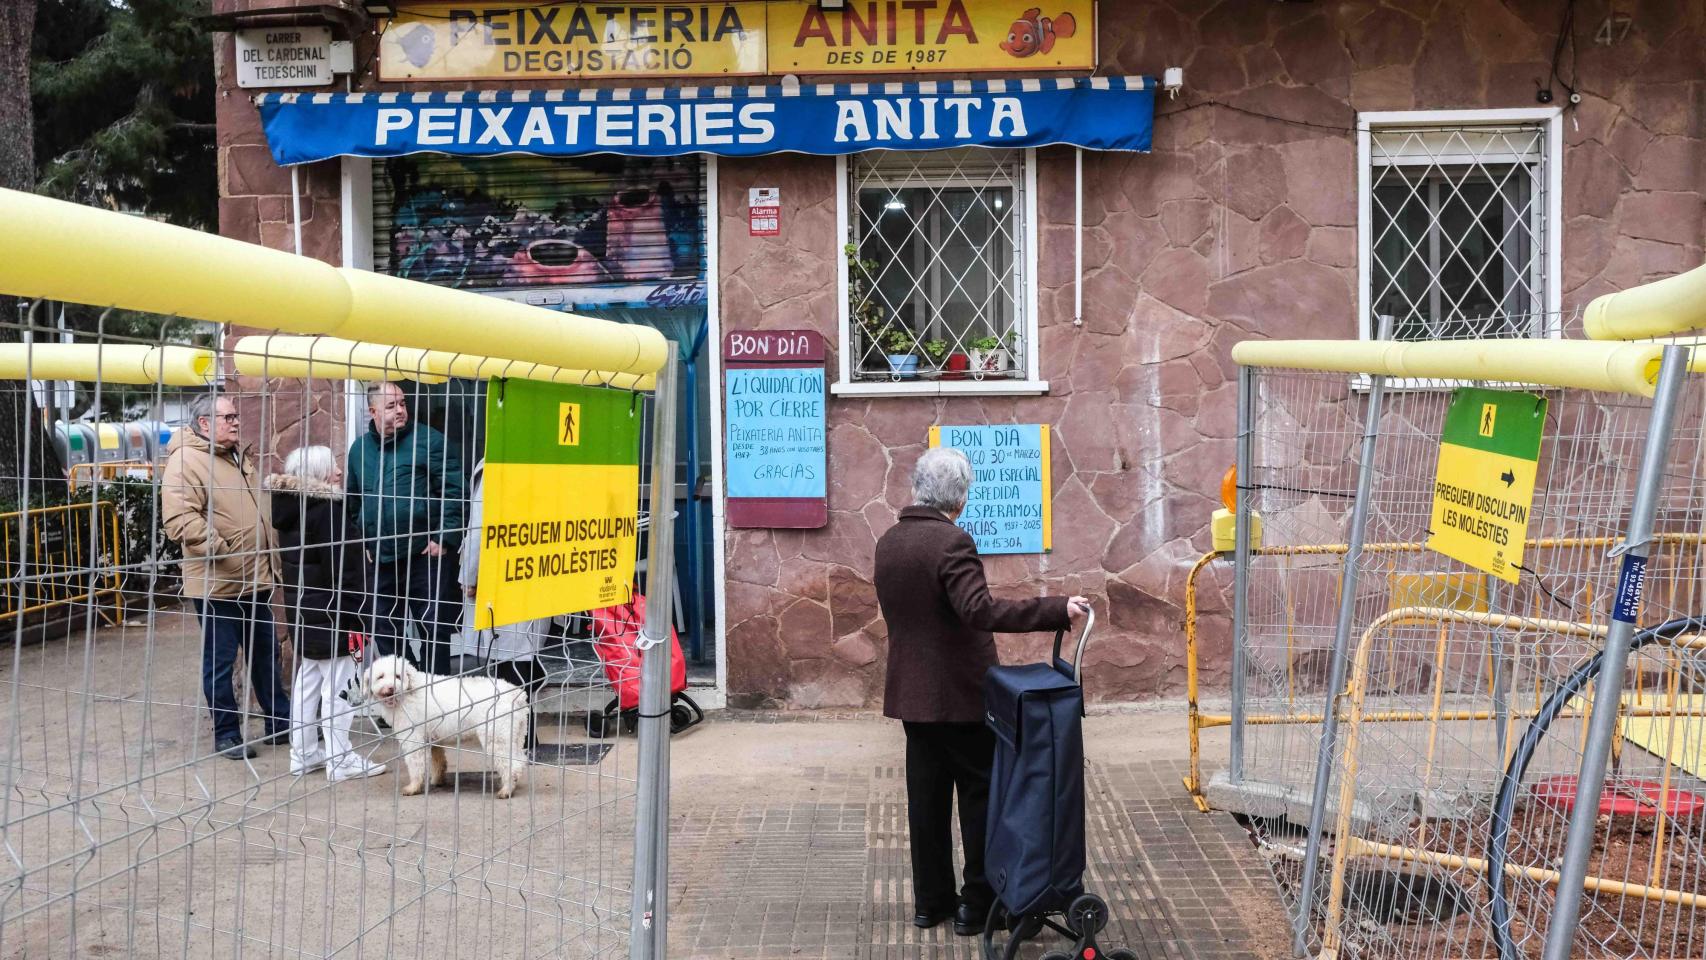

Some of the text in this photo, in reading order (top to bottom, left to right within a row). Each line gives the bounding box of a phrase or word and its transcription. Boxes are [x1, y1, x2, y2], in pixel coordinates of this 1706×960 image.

[449, 0, 979, 48] PEIXATERIA ANITA
[1595, 17, 1632, 45] 47
[266, 32, 301, 44] CARRER
[243, 47, 325, 62] DEL CARDENAL
[504, 44, 692, 72] DEGUSTACIÓ
[827, 49, 947, 64] DES DE 1987
[255, 65, 317, 79] TEDESCHINI
[375, 97, 1028, 146] PEIXATERIES ANITA
[731, 334, 769, 356] BON
[735, 398, 819, 418] POR CIERRE
[788, 425, 822, 441] ANITA
[951, 430, 982, 447] BON
[733, 443, 755, 451] DESDE
[760, 445, 769, 455] 38
[991, 449, 1005, 464] 30
[1014, 449, 1040, 459] MARZO
[754, 464, 815, 480] GRACIAS
[1000, 466, 1042, 482] ESPECIAL
[967, 485, 1020, 500] ESPEDIDA
[1436, 482, 1526, 524] PREGUEM DISCULPIN
[486, 517, 635, 549] PREGUEM DISCULPIN
[958, 519, 998, 536] RACIAS
[1442, 508, 1508, 546] LES MOLÈSTIES
[505, 546, 617, 582] LES MOLÈSTIES
[1622, 608, 1629, 616] 17
